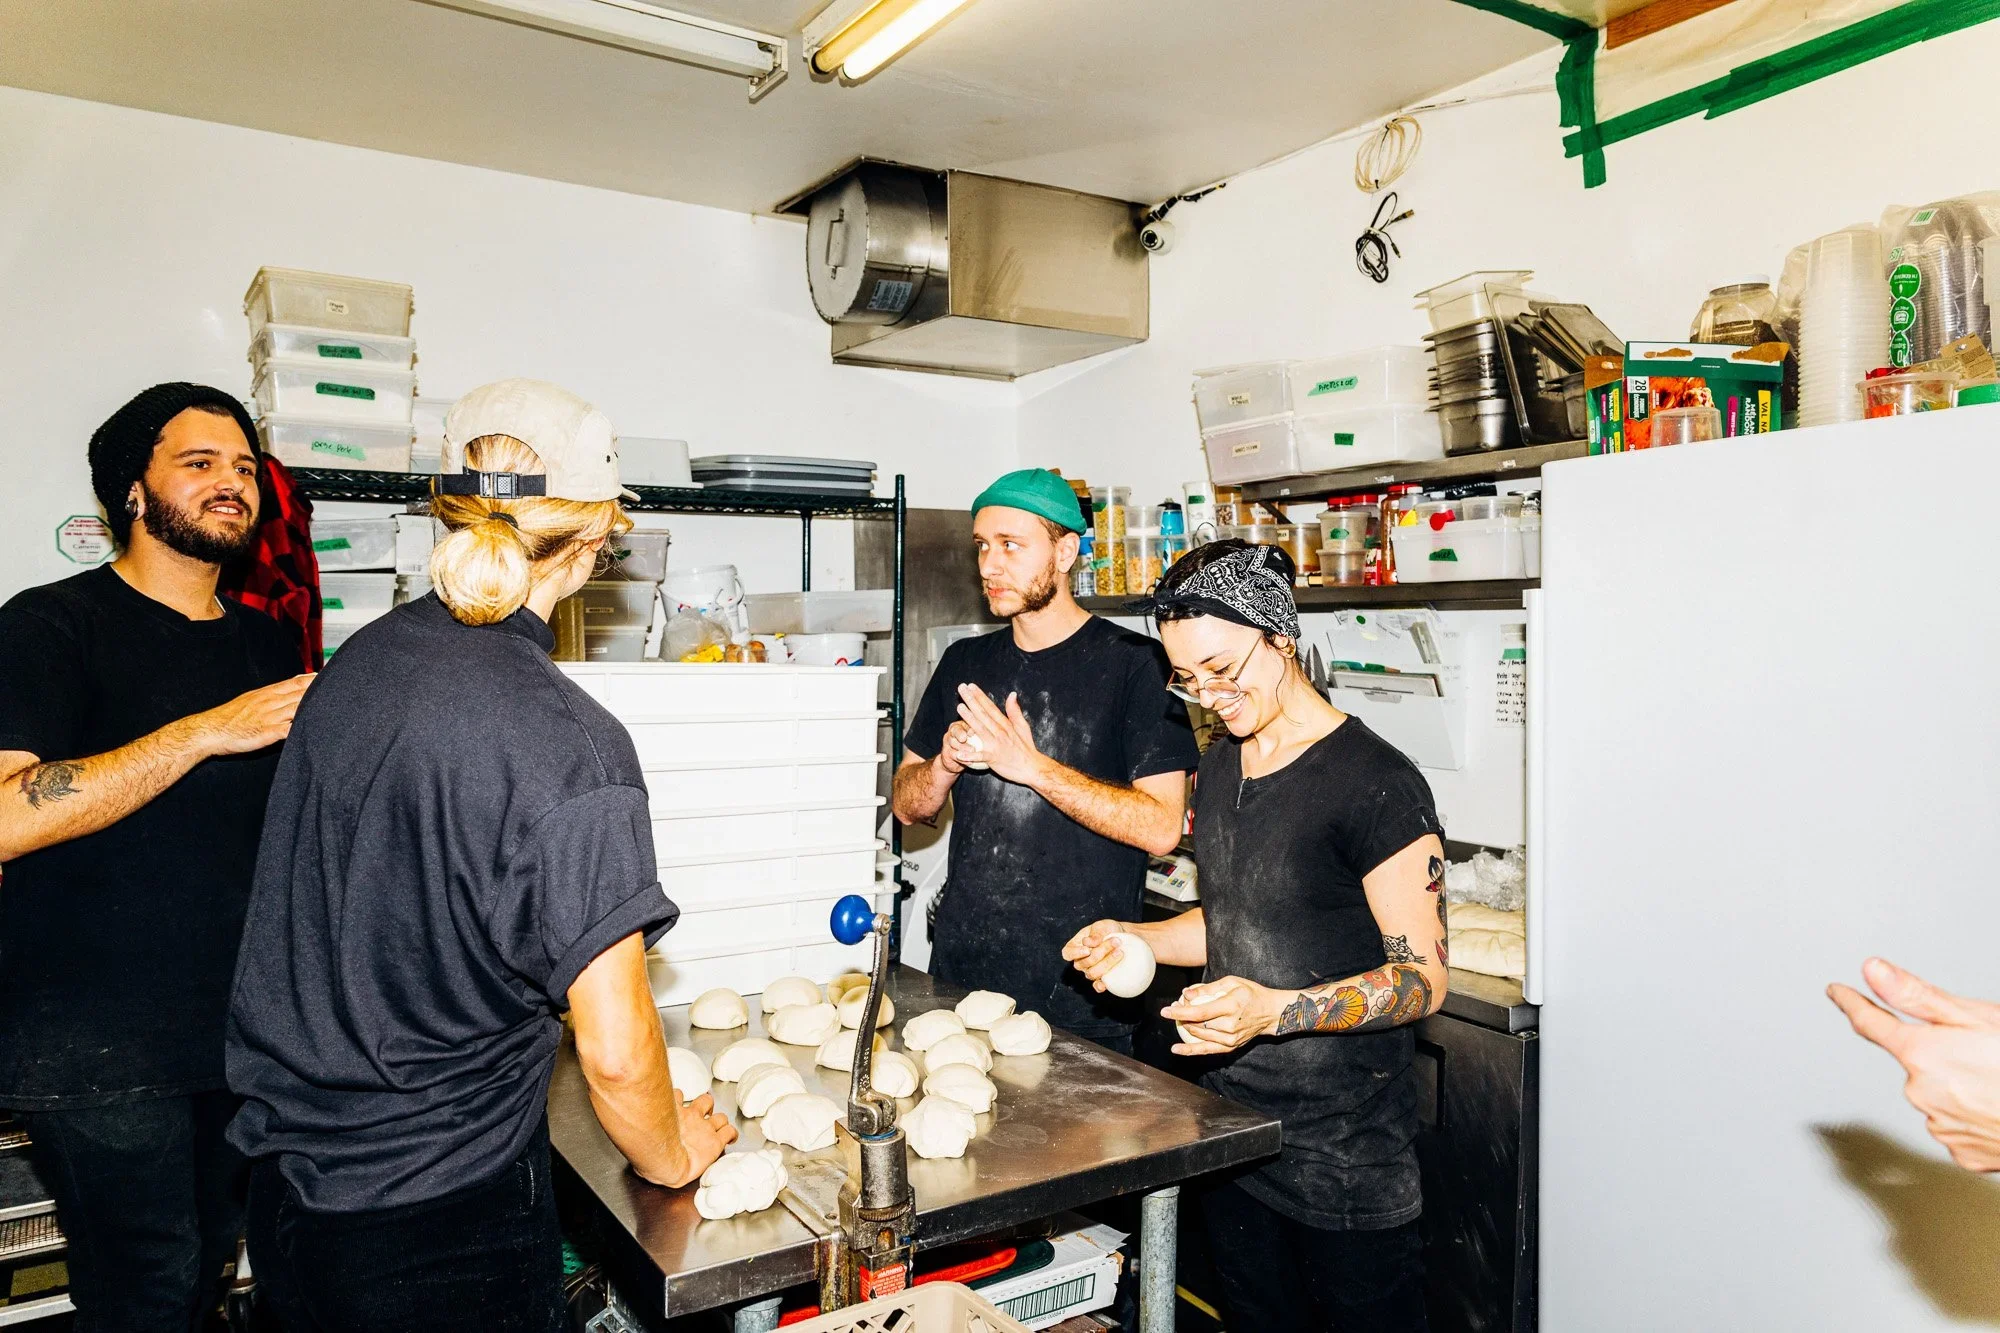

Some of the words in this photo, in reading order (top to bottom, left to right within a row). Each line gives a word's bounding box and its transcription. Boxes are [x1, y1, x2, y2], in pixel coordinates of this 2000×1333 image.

[1634, 379, 1647, 391] 28
[1744, 397, 1752, 435] RANDON
[1760, 401, 1769, 418] VAL
[1748, 403, 1757, 434] MÉLAN
[1760, 421, 1769, 434] NA
[877, 1265, 904, 1279] WARNING
